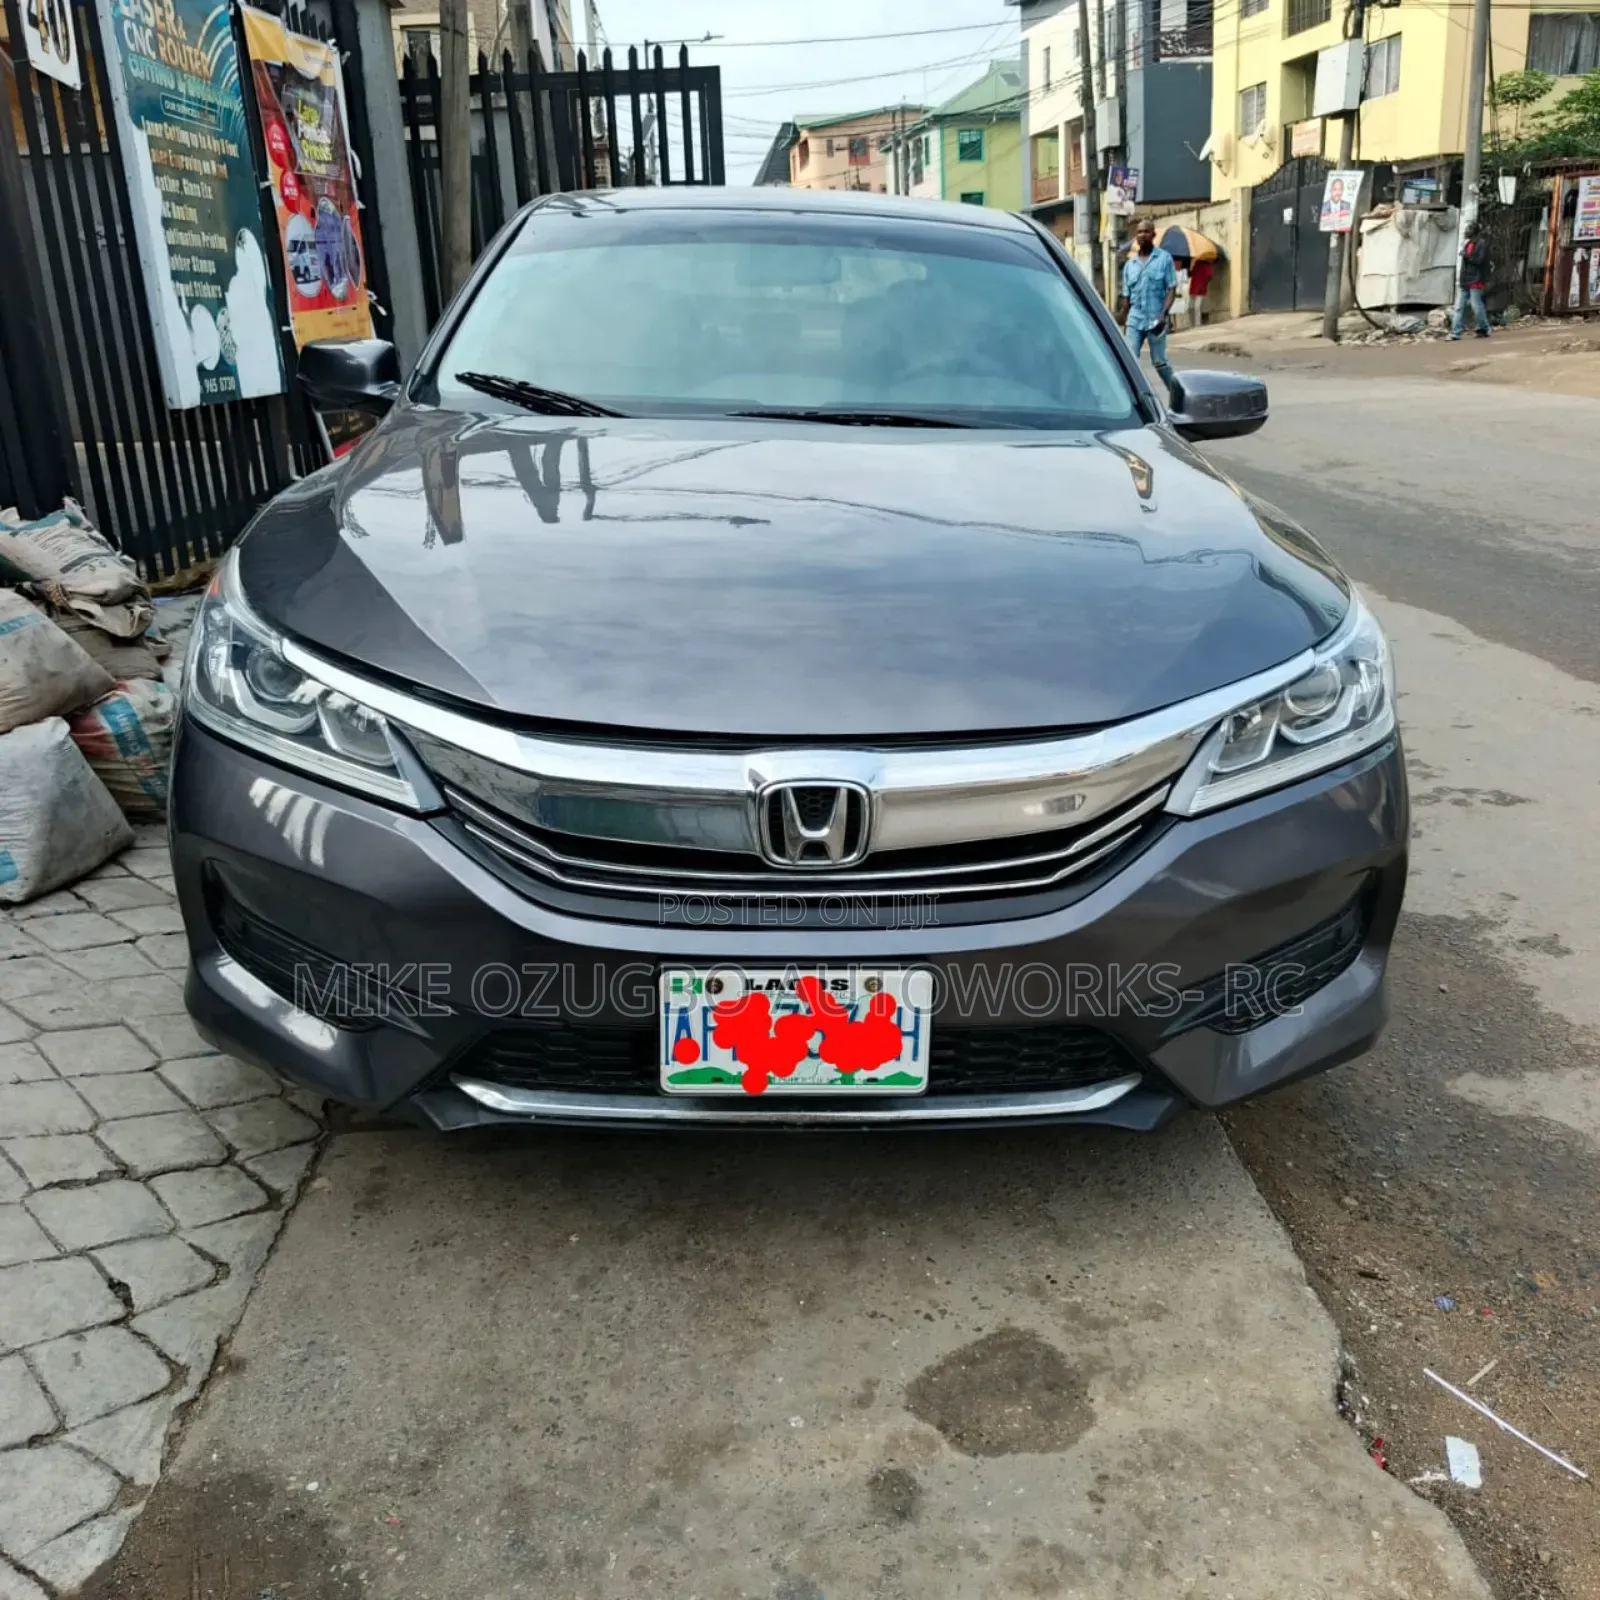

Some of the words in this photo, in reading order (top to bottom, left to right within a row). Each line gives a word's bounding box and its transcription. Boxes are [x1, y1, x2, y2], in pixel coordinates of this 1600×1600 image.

[123, 19, 156, 60] CNC
[157, 32, 211, 82] ROUTER
[165, 228, 201, 248] ublimation
[170, 254, 190, 271] ubber
[745, 978, 849, 991] LAS
